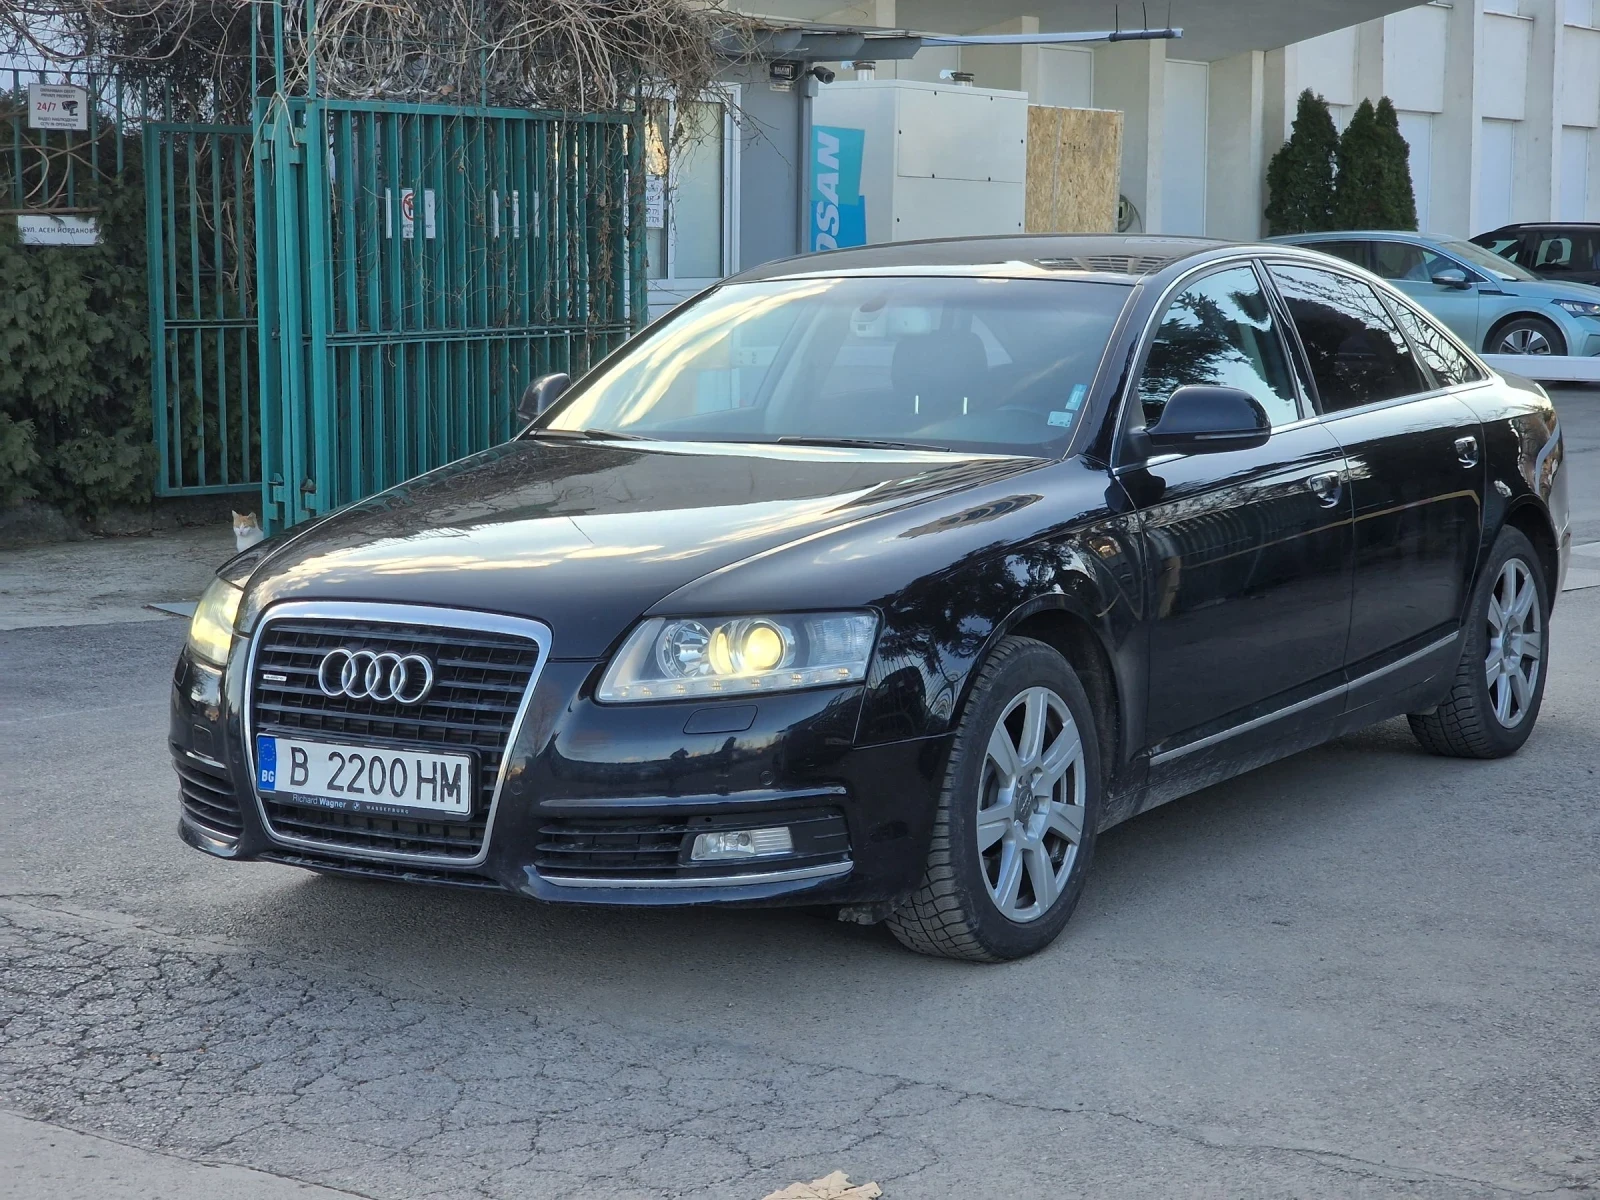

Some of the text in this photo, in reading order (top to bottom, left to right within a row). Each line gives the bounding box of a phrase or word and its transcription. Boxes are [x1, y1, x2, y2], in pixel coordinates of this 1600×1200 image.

[37, 101, 57, 112] 24/7
[261, 769, 275, 783] BG
[290, 746, 462, 805] B 2200 HM
[292, 793, 318, 805] Richard
[319, 797, 347, 809] Wagner
